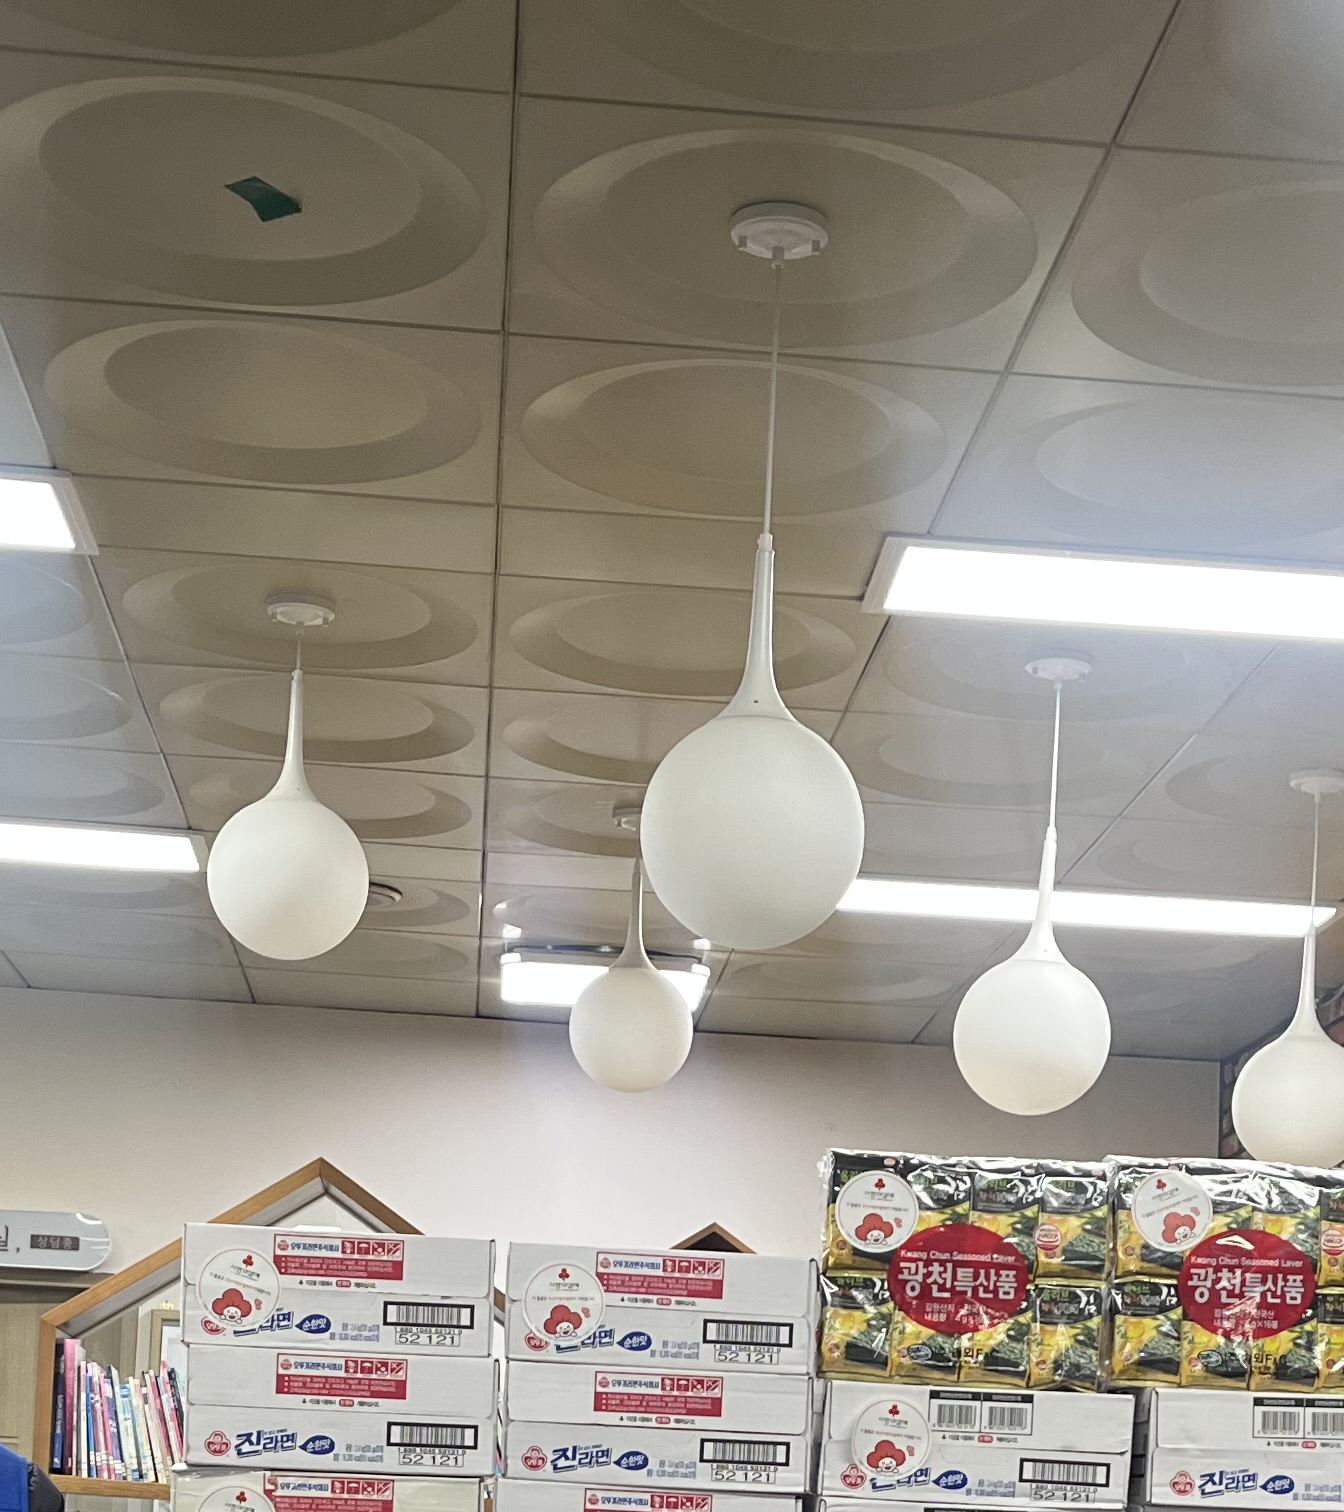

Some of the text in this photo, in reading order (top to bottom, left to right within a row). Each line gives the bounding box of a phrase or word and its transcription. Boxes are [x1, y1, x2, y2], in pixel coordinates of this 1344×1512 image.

[900, 1250, 927, 1261] Kwang
[930, 1250, 951, 1259] Chun
[952, 1251, 991, 1261] Seasoned
[1190, 1256, 1303, 1268] Kwang Chun Seasoned Laver
[898, 1262, 1018, 1300] 광천특산품
[1187, 1269, 1305, 1305] 광천특산품
[234, 1429, 298, 1458] 진라면
[551, 1445, 613, 1473] 진라면
[1197, 1470, 1258, 1498] 진라면
